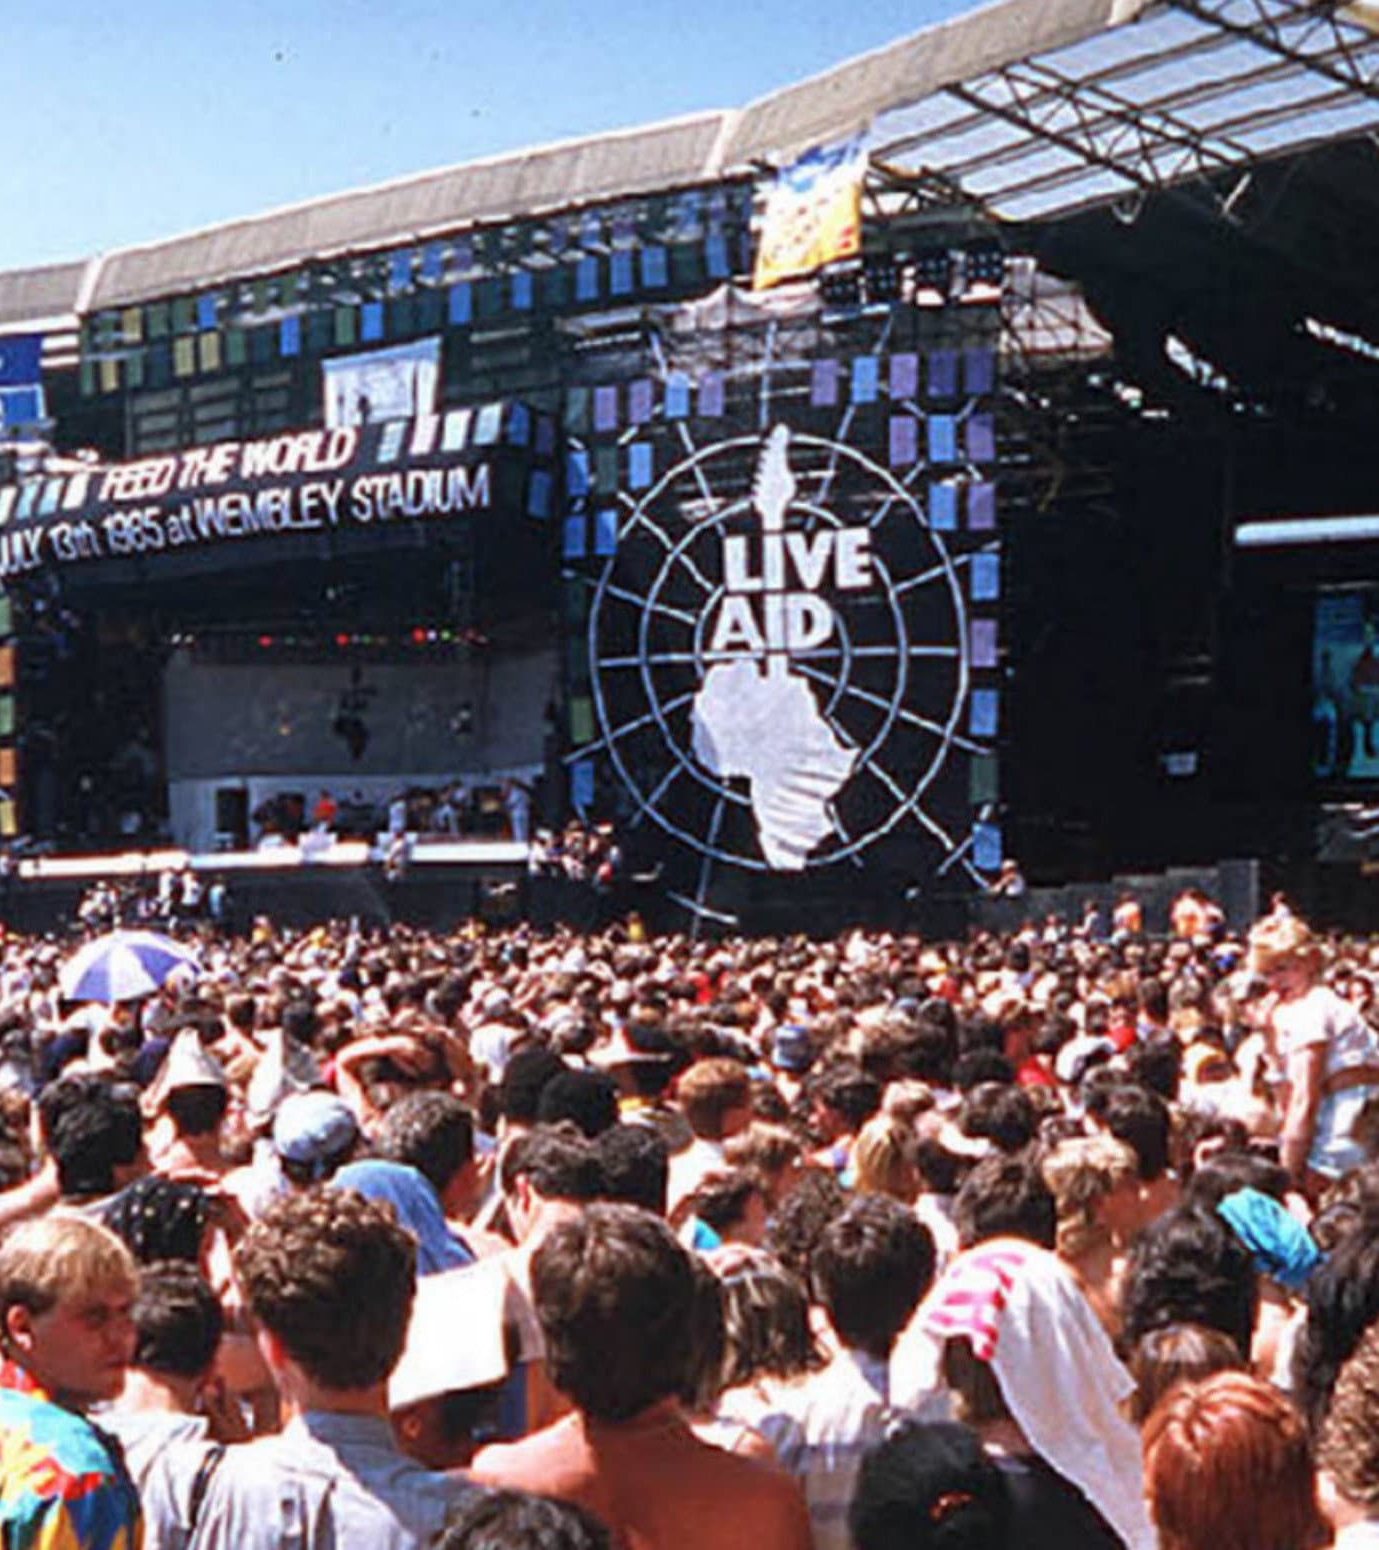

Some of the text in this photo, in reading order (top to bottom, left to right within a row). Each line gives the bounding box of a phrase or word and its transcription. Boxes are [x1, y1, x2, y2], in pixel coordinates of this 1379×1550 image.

[98, 424, 359, 501] FEED THE WORLD
[49, 521, 101, 561] 13th
[102, 505, 165, 554] 1985
[167, 505, 197, 545] at
[194, 479, 345, 537] WEMBLEY
[350, 463, 490, 523] STADIUM
[724, 527, 872, 591] LIVE
[711, 591, 834, 653] AID
